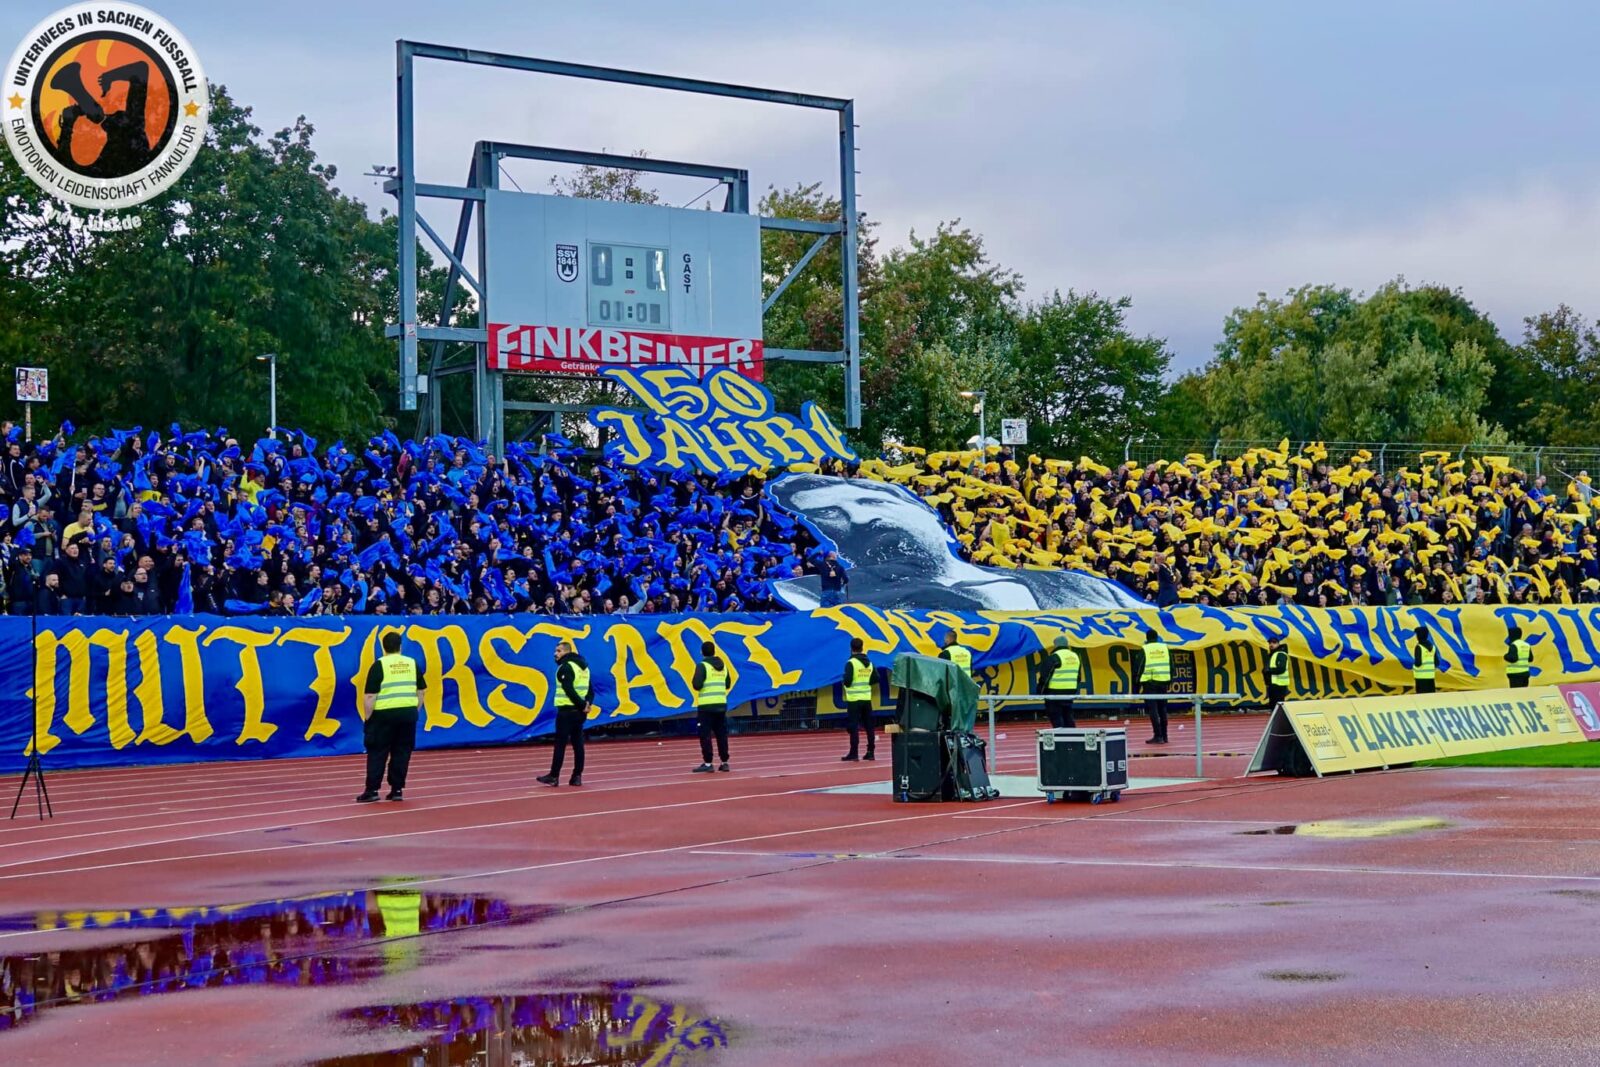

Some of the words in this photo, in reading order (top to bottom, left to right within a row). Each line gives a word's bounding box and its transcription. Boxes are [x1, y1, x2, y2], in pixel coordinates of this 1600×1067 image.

[557, 249, 577, 258] SSV
[557, 257, 577, 266] 1846
[682, 253, 692, 294] GAST
[497, 321, 756, 381] FINKBEINER
[604, 369, 767, 421] 150
[1337, 700, 1550, 753] PLAKAT-VERKAUFT.DE
